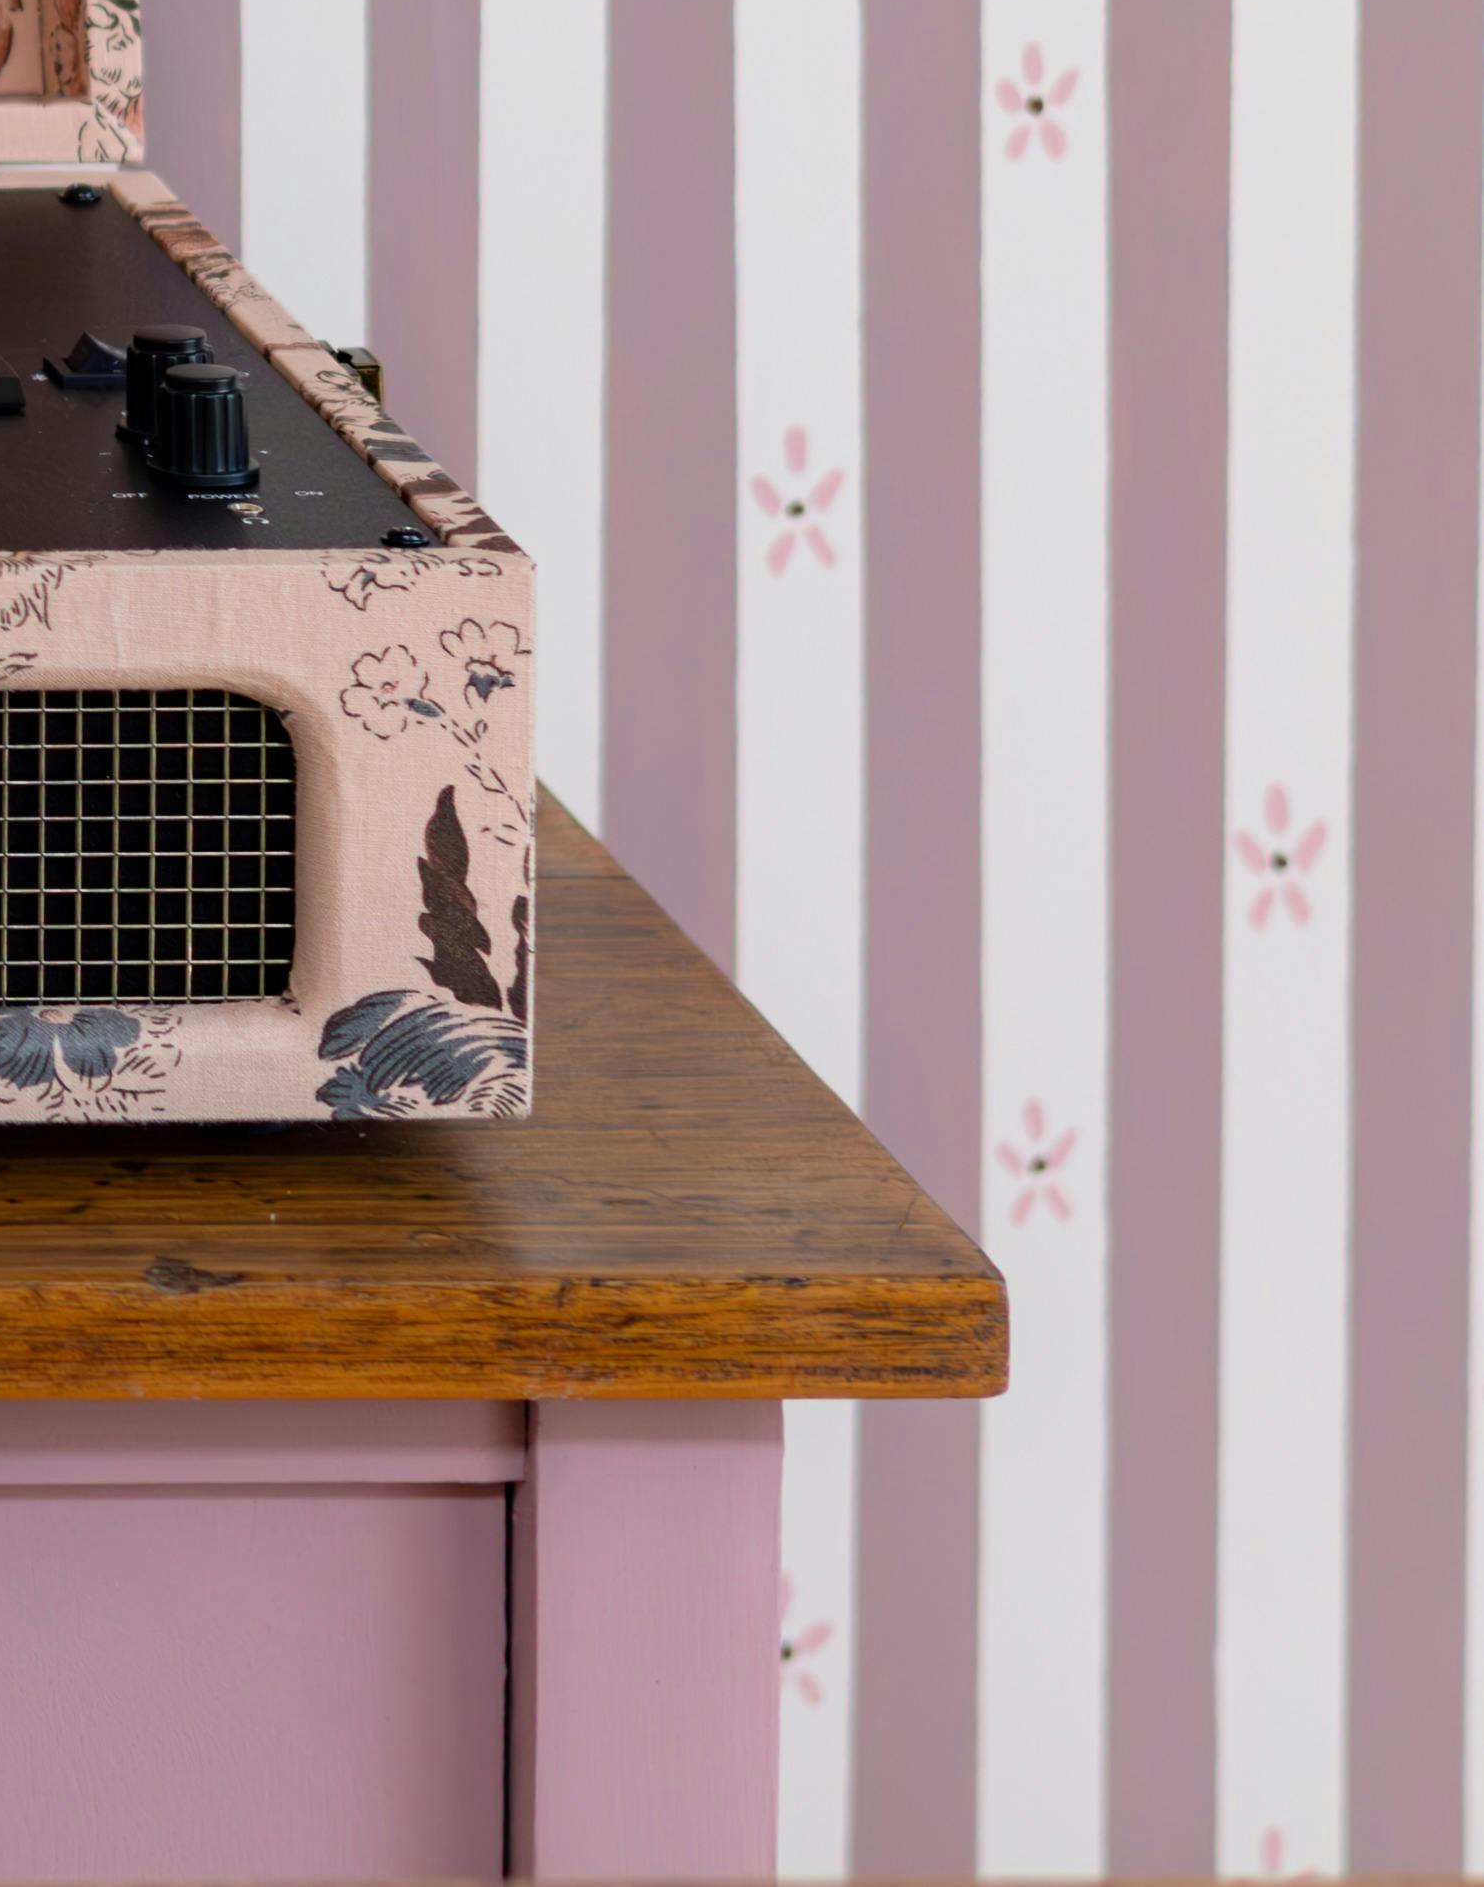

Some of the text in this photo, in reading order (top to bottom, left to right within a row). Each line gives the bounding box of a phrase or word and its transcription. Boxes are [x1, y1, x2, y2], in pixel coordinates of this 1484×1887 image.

[111, 489, 325, 501] OFF POWER ON
